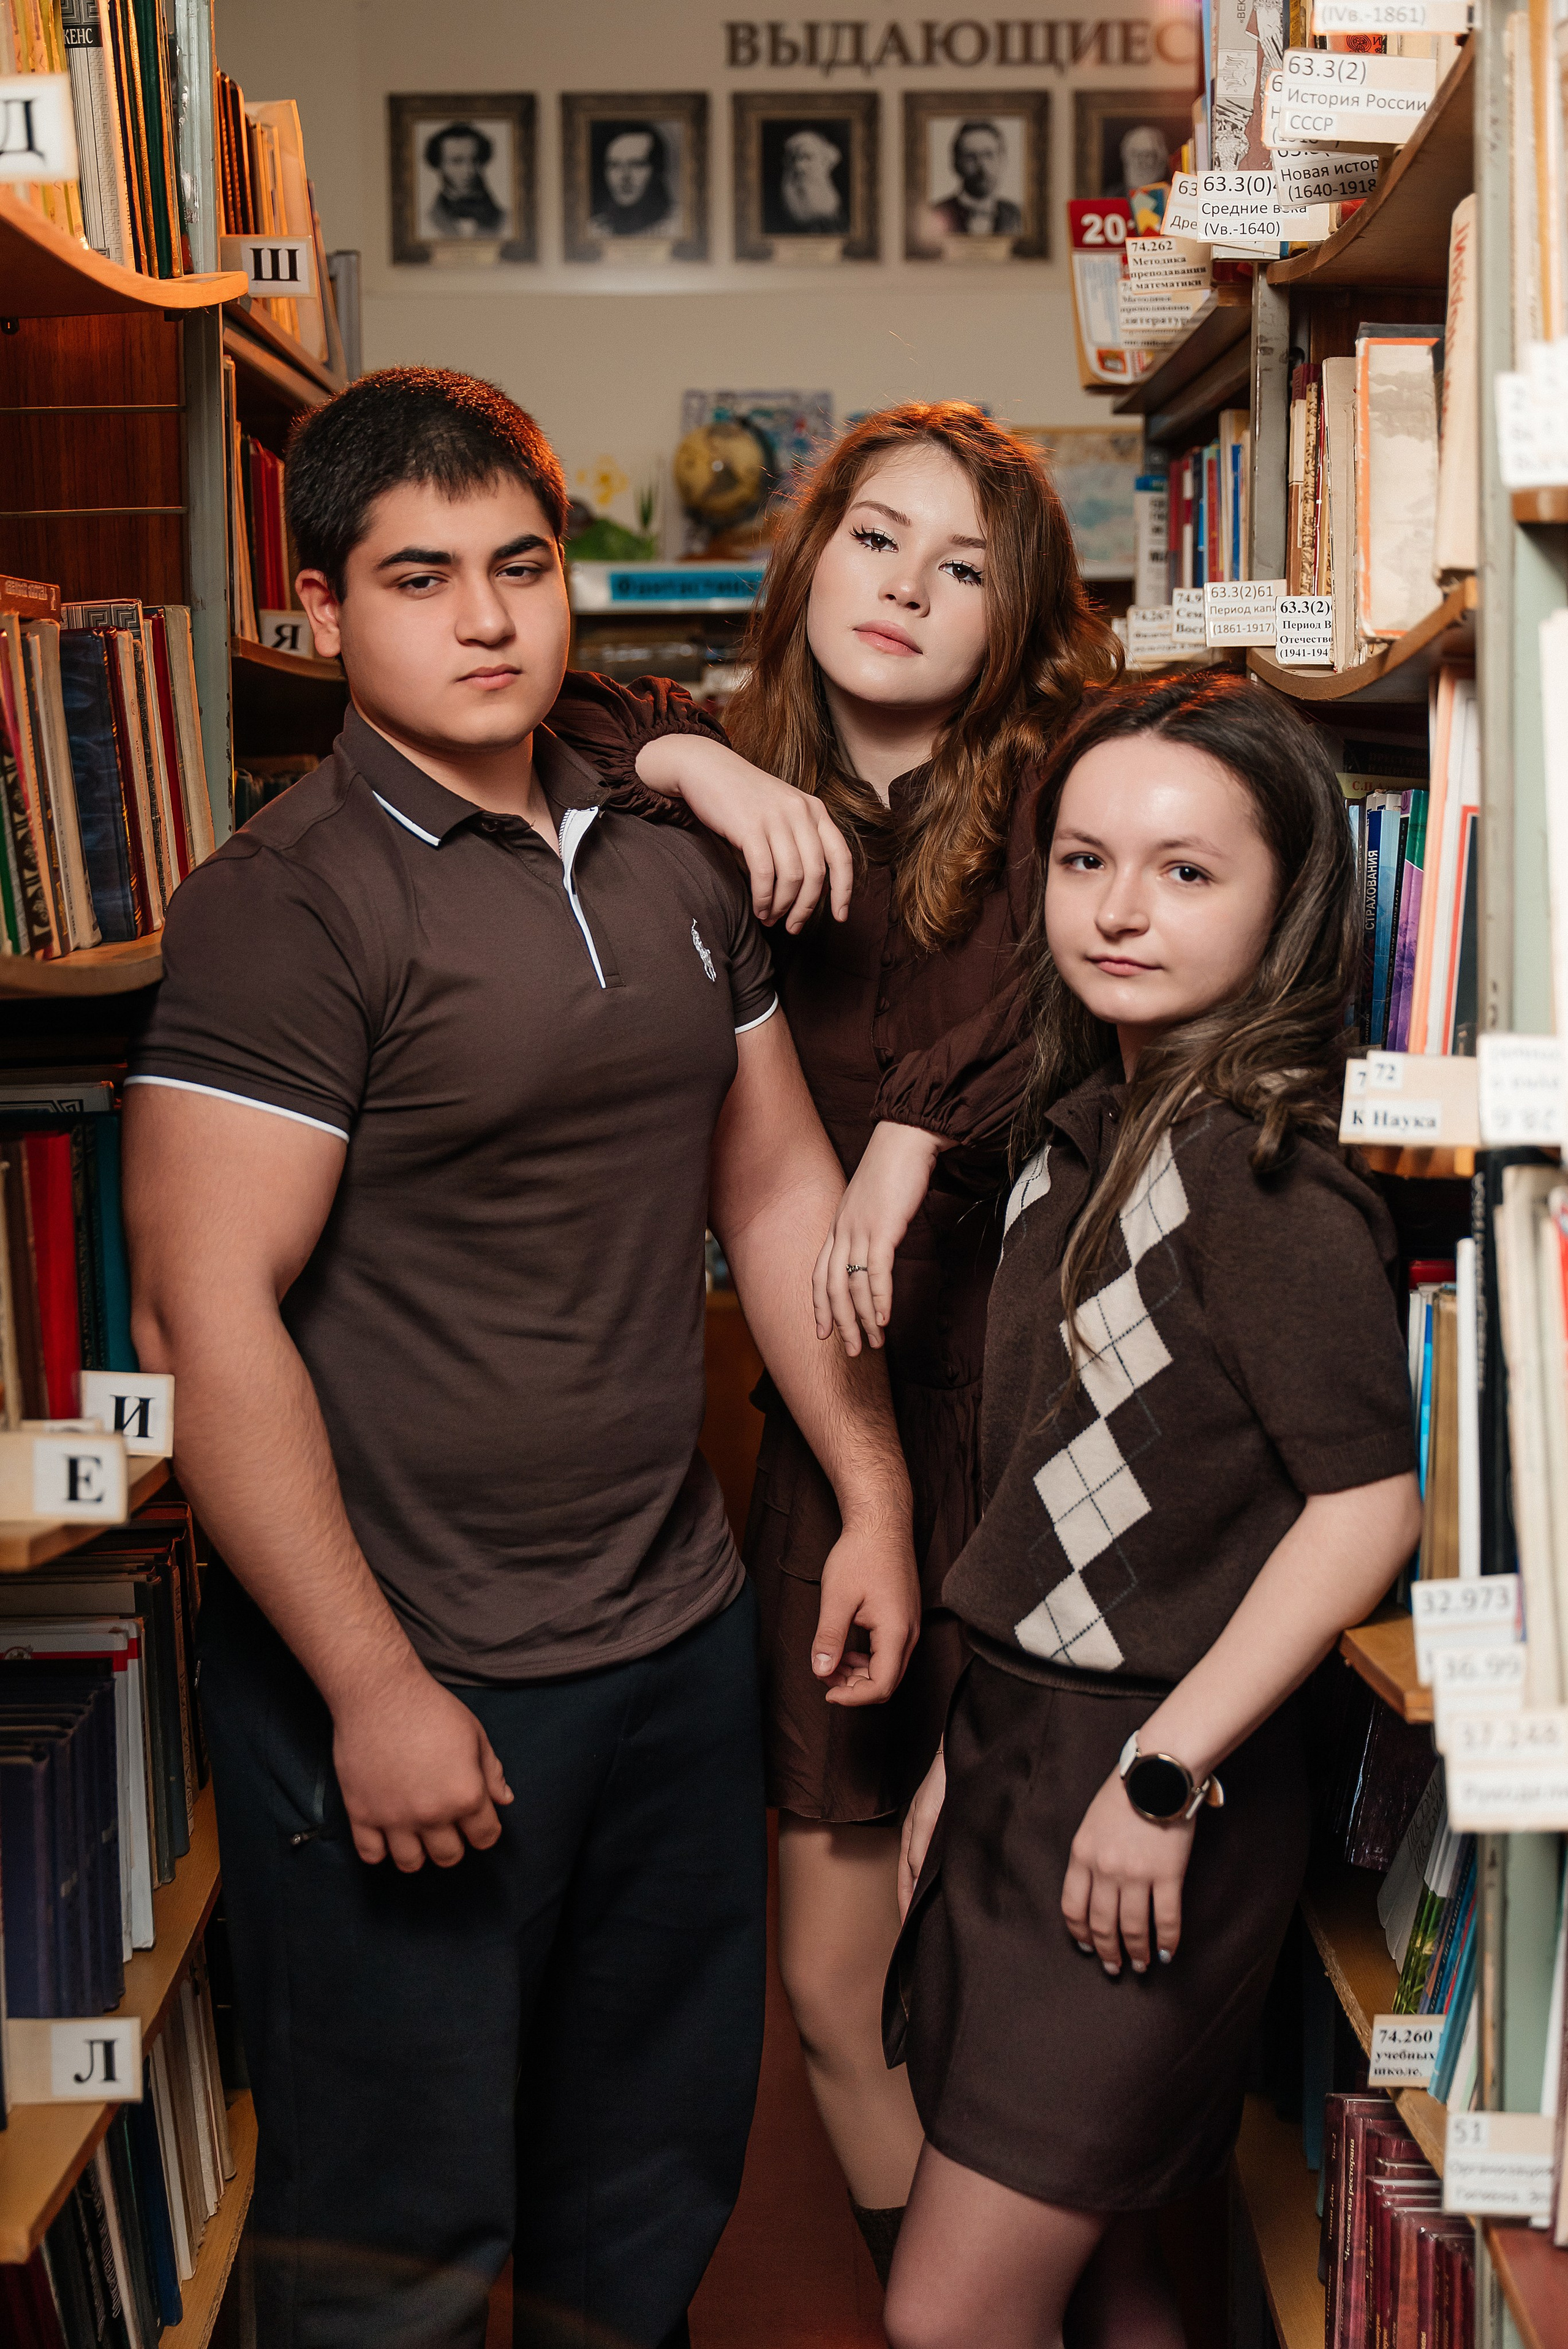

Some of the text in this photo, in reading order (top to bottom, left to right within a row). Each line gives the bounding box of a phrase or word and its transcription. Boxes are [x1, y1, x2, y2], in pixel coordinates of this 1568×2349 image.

[1288, 56, 1366, 84] 63.3(2)
[1287, 89, 1427, 111] История России
[1290, 115, 1333, 131] СССР
[1281, 166, 1329, 182] Новая
[1203, 176, 1277, 196] 63.3(0)
[1202, 202, 1268, 217] Средние
[1204, 222, 1280, 237] (Vв.-1640)
[1131, 241, 1172, 252] 74.262
[250, 247, 300, 281] Ш
[1133, 256, 1186, 266] Методика
[1131, 266, 1207, 279] преподавания
[1136, 280, 1202, 289] математики
[1211, 585, 1273, 600] 63.3(2)61
[1210, 606, 1251, 618] Период
[1280, 600, 1332, 617] 63.3(2)
[1213, 621, 1275, 635] (1861-1917)
[1283, 620, 1321, 631] Период
[271, 622, 300, 650] Я
[1280, 648, 1329, 660] (1941-194
[1365, 850, 1378, 931] СТРАХОВАНИЯ
[1376, 1063, 1396, 1080] 72
[1374, 1110, 1437, 1133] Наука
[110, 1395, 154, 1438] И
[63, 1454, 105, 1503] Е
[1379, 2028, 1433, 2044] 74.260
[73, 2038, 119, 2084] Л
[1376, 2049, 1436, 2063] учебных
[1343, 2211, 1352, 2261] Человек
[1348, 2196, 1352, 2211] из
